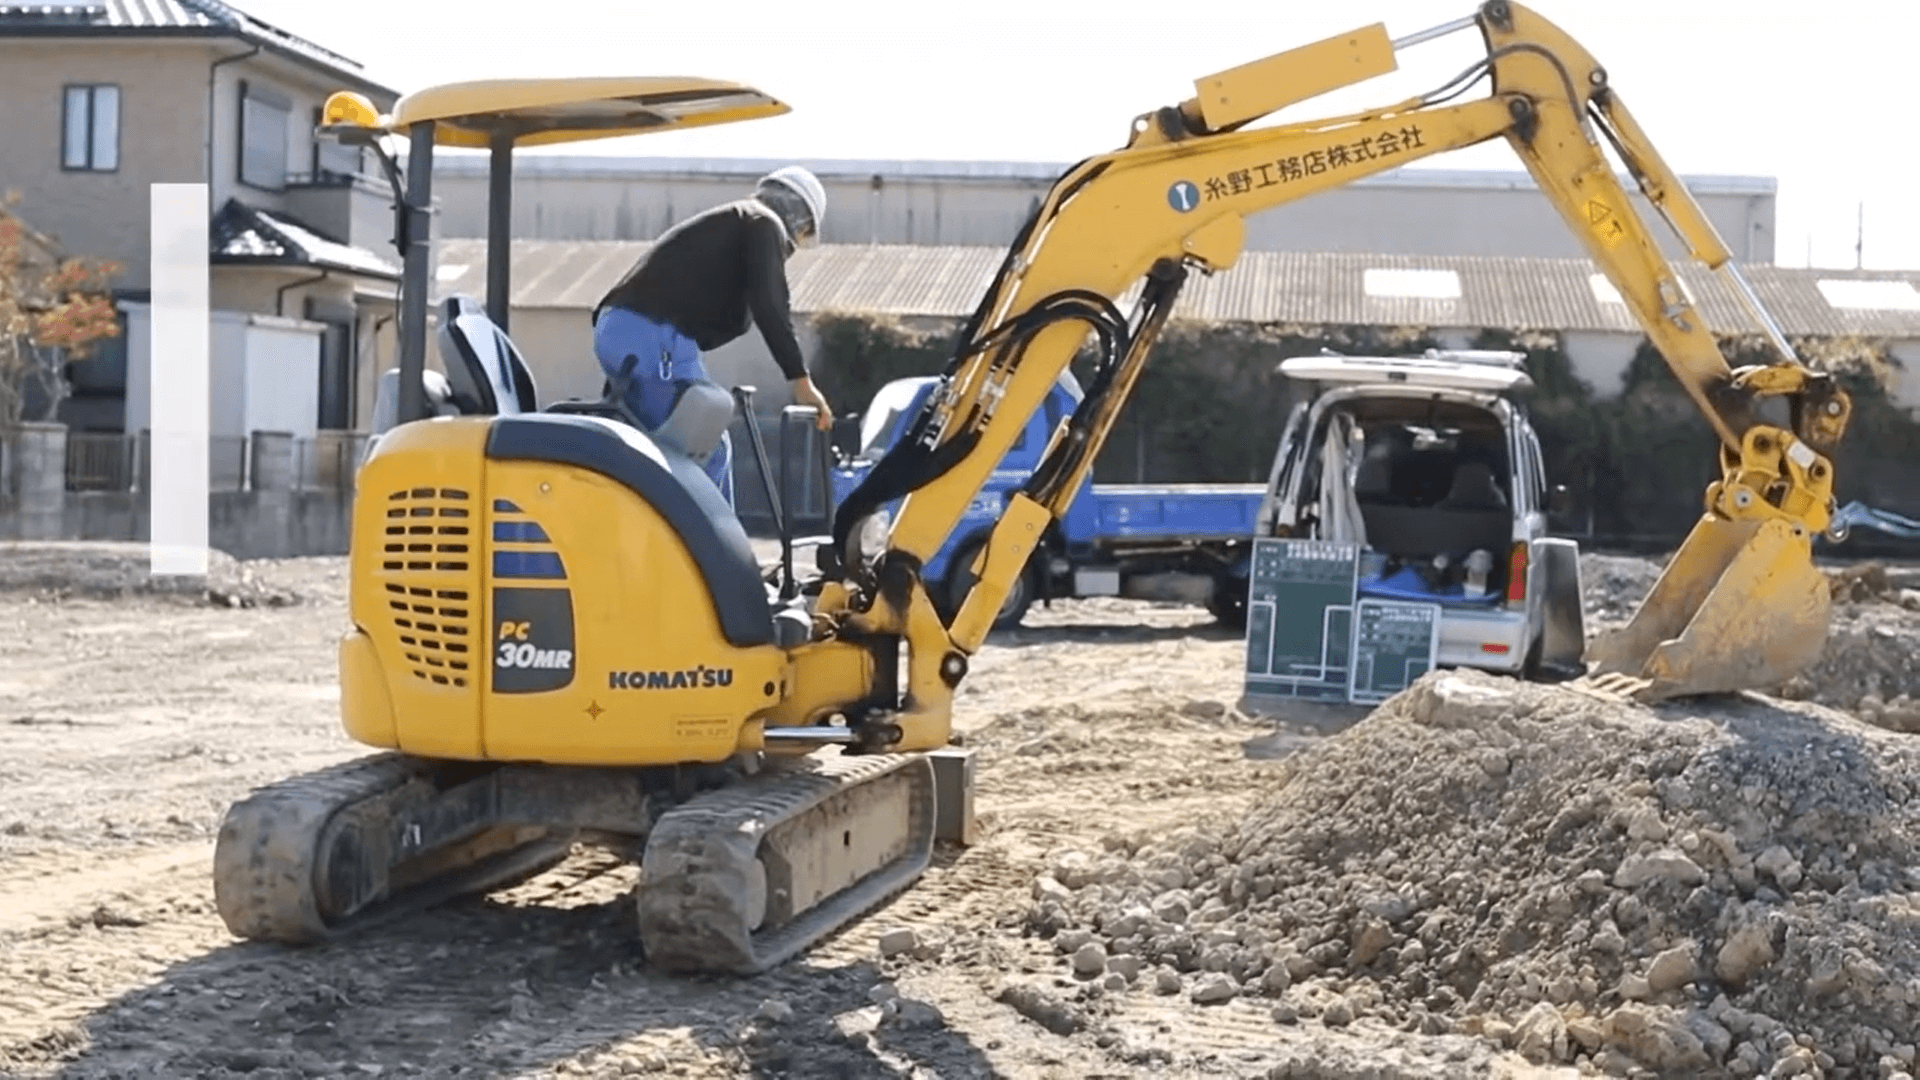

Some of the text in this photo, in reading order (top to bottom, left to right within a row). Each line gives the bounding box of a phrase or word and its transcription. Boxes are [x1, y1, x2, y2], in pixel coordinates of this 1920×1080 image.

[1205, 125, 1425, 201] 糸野工務店株式会社
[499, 621, 530, 640] PC
[496, 643, 571, 669] 30MR
[609, 665, 733, 690] KOMATSU
